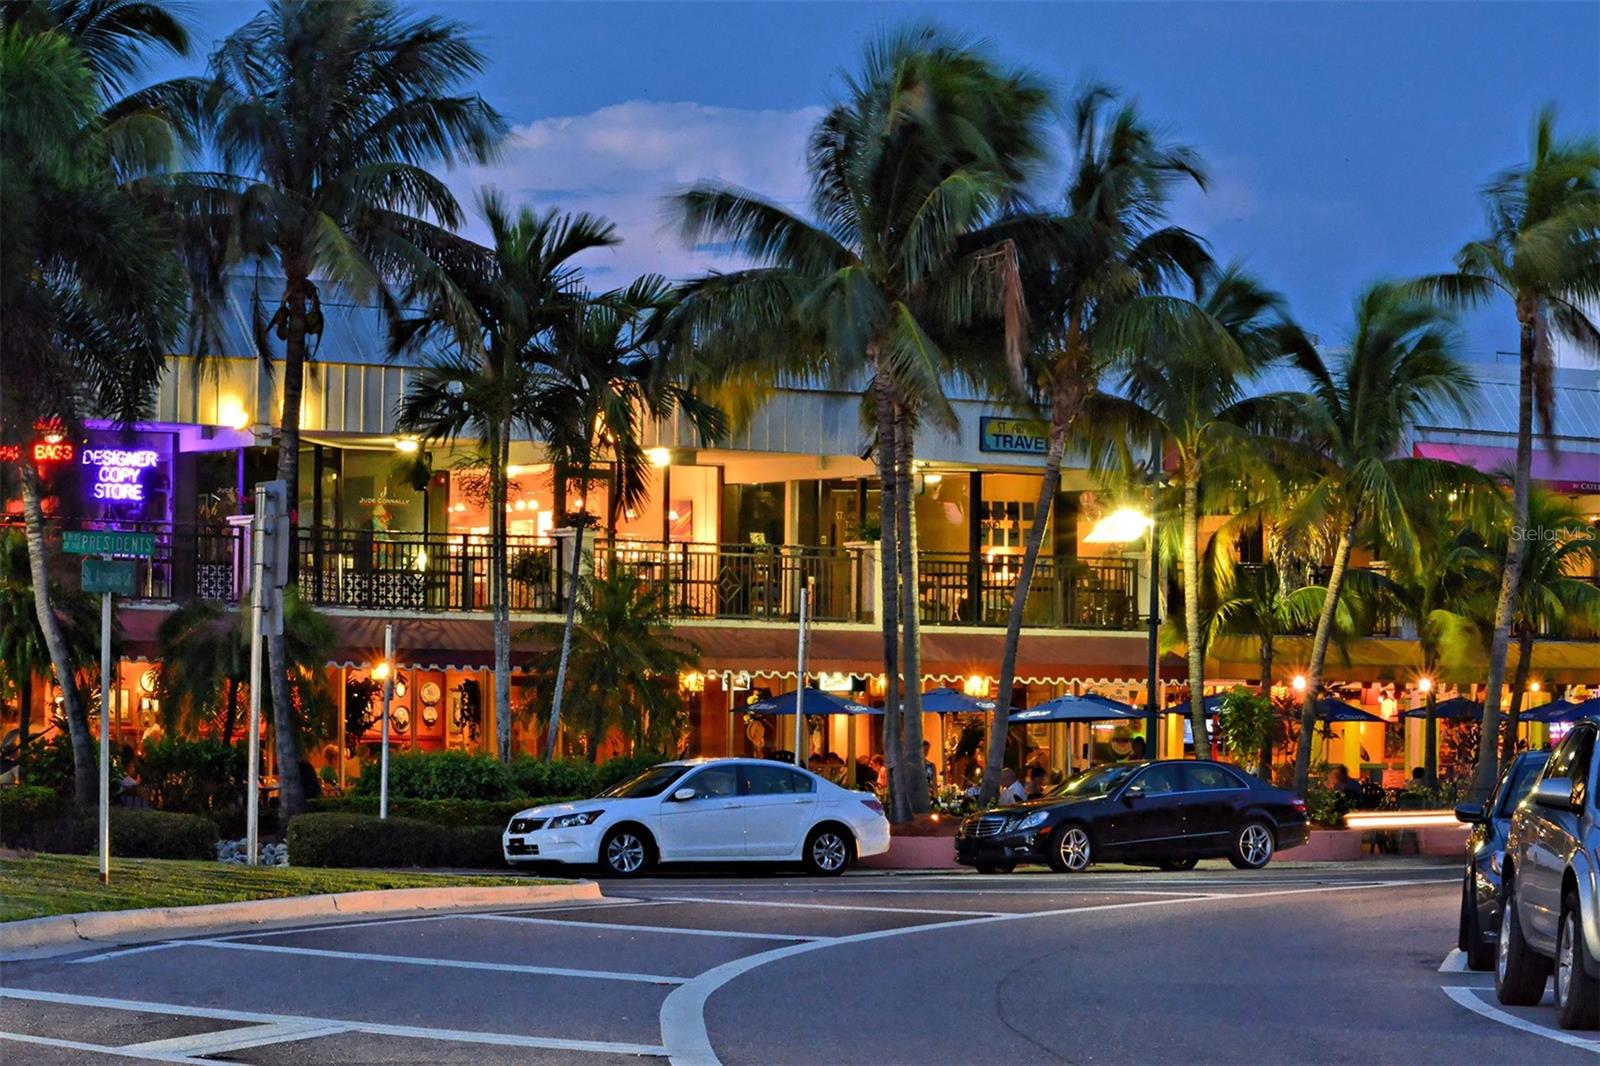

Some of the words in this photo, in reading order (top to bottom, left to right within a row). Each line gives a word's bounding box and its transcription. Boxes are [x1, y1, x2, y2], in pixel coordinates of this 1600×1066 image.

[35, 445, 73, 460] BAGS
[82, 450, 158, 467] DESIGNER
[99, 467, 141, 482] COPY
[94, 483, 143, 500] STORE
[81, 534, 152, 552] PRESIDENTS
